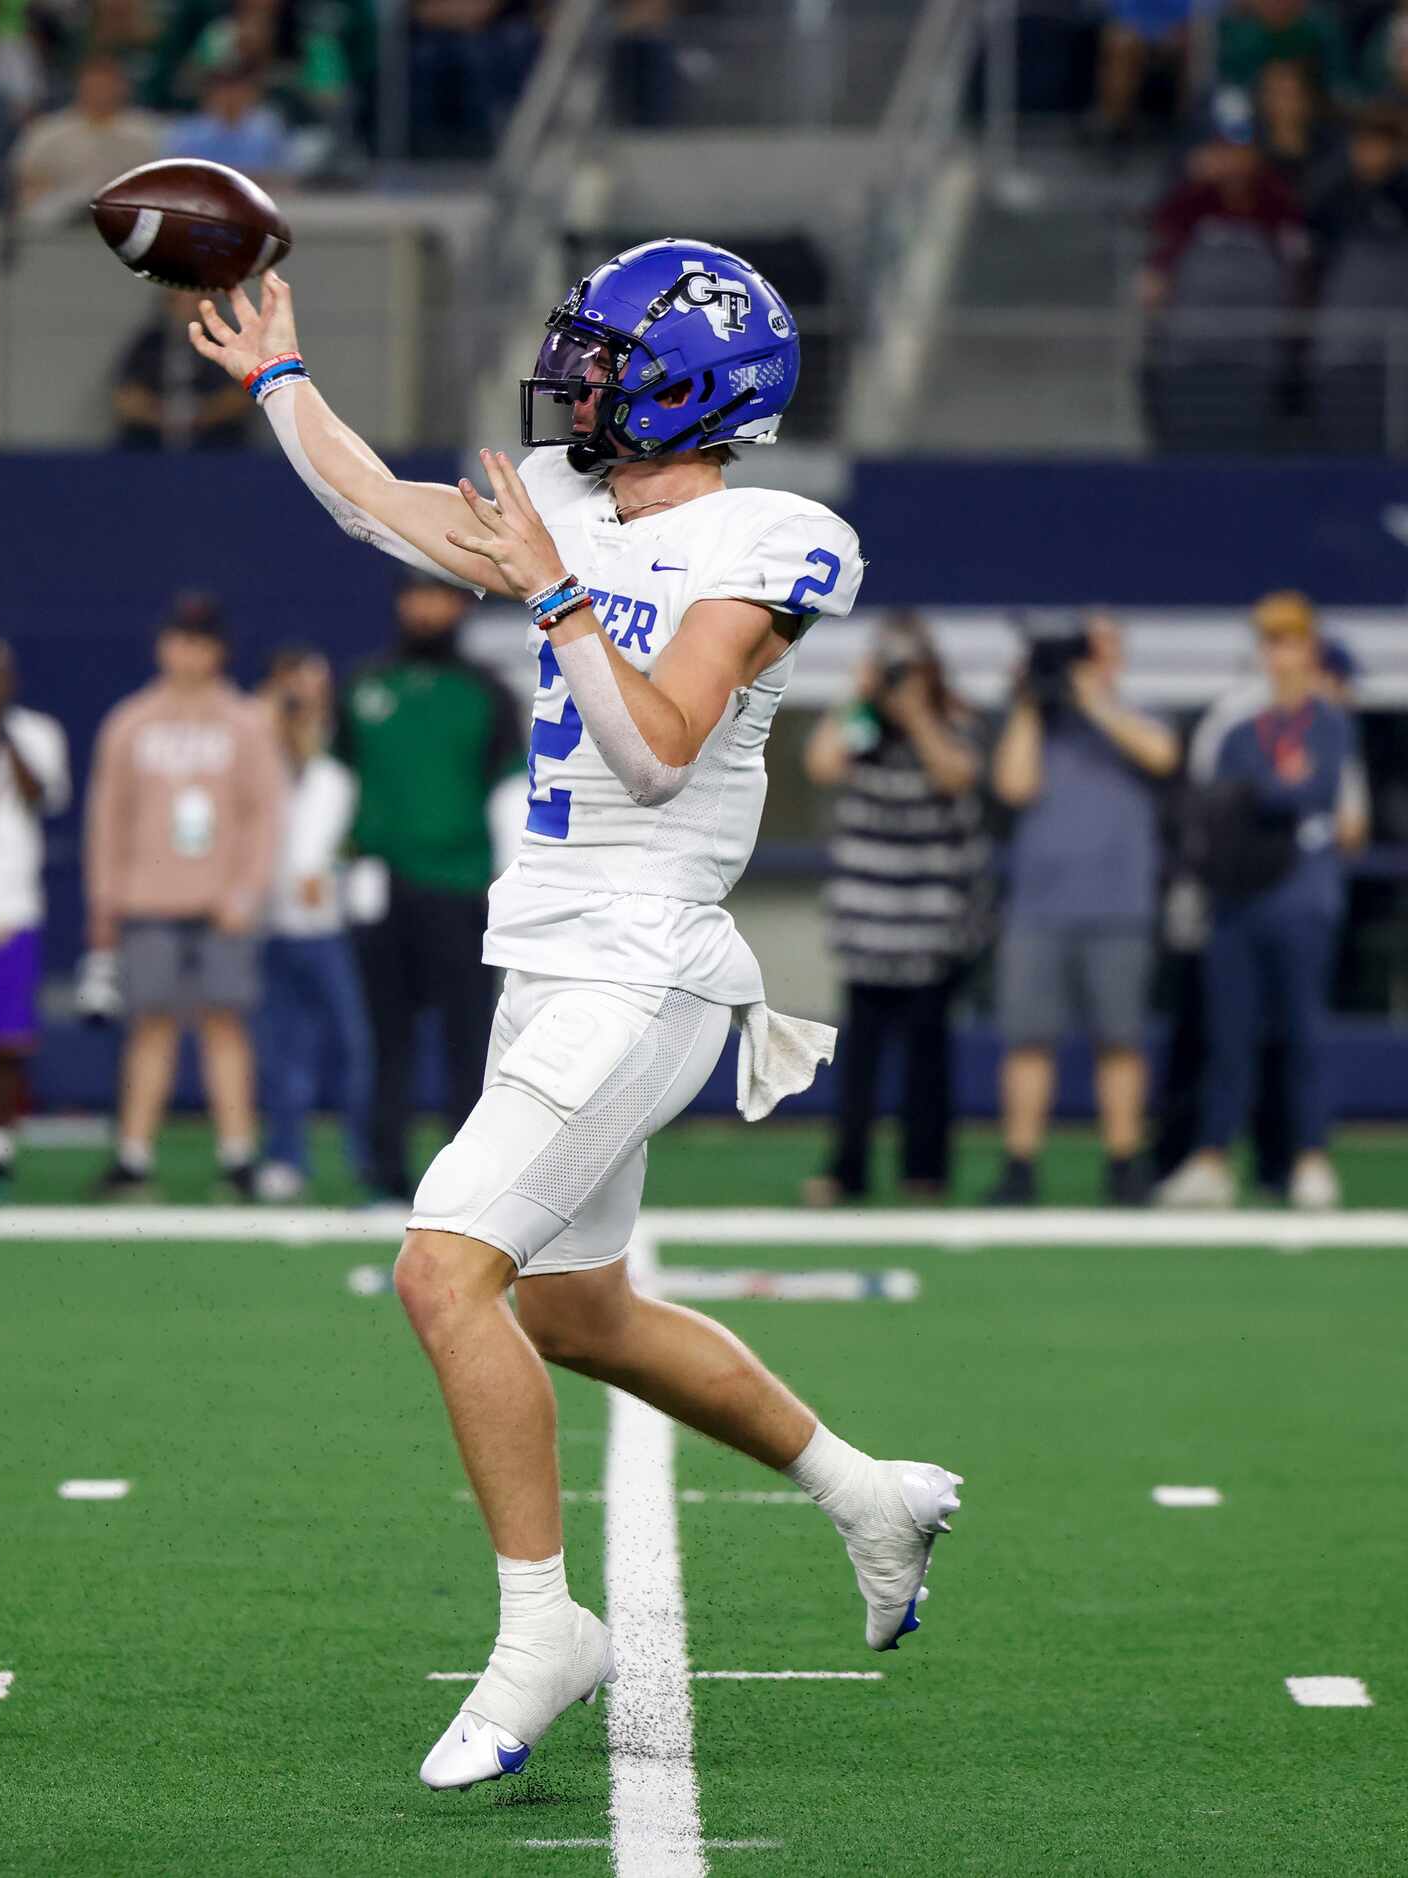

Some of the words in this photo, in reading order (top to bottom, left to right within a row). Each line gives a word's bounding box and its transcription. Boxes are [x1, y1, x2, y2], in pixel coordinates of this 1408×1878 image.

[673, 269, 752, 334] GT
[785, 547, 841, 615] 2
[581, 585, 658, 655] TER
[526, 639, 584, 840] 2
